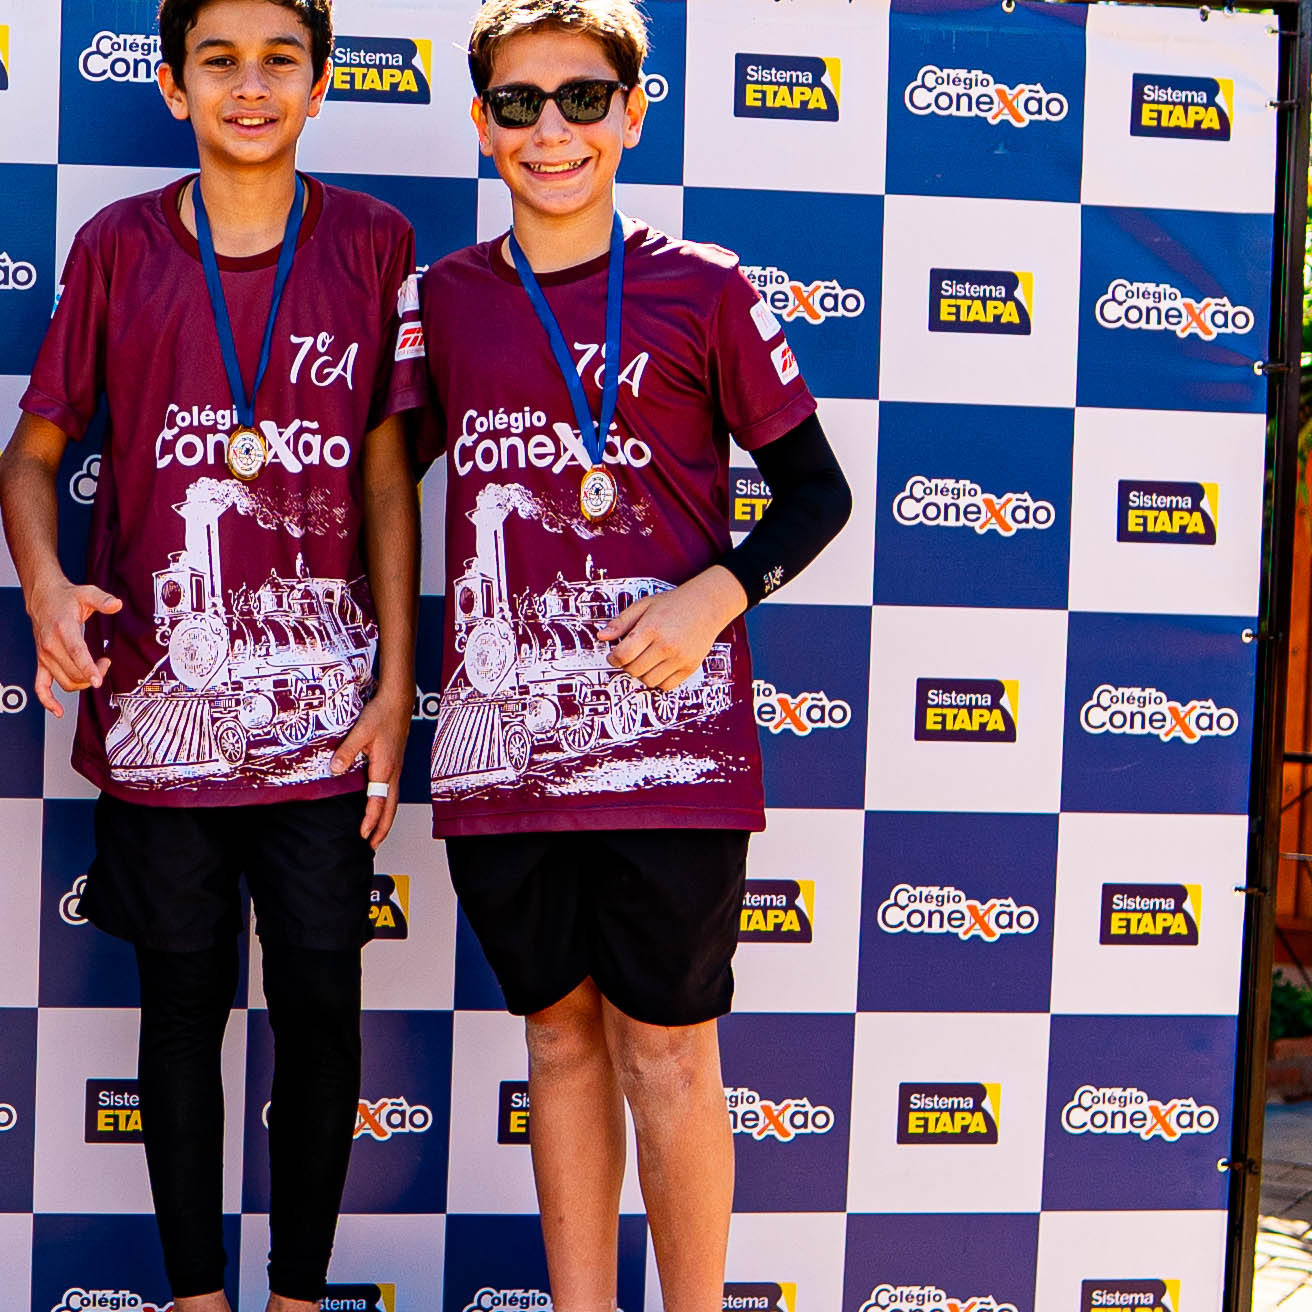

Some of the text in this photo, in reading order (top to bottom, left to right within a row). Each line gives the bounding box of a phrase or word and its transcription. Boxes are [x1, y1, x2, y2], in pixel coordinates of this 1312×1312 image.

[94, 34, 161, 58] Colégi
[333, 47, 403, 67] Sistema
[332, 66, 419, 92] ETAPA
[746, 64, 813, 84] Sistema
[919, 68, 989, 92] Colégio
[745, 83, 828, 109] ETAPA
[1143, 86, 1207, 106] Sistema
[1142, 104, 1221, 131] ETAPA
[741, 268, 786, 287] égio
[941, 278, 1007, 298] Sistema
[1110, 282, 1178, 305] Colégio
[940, 297, 1021, 323] ETAPA
[164, 403, 239, 434] Colégi
[462, 406, 547, 440] Colégio
[908, 478, 978, 502] Colégio
[1129, 490, 1193, 509] Sistema
[1128, 508, 1207, 534] ETAPA
[927, 688, 993, 706] Sistema
[1096, 687, 1163, 711] Colégio
[756, 694, 848, 731] eXão
[926, 706, 1007, 731] ETAPA
[741, 890, 788, 907] tema
[893, 886, 962, 910] Colégio
[1112, 893, 1175, 911] Sistema
[739, 907, 802, 931] TAPA
[1110, 912, 1189, 935] ETAPA
[97, 1090, 139, 1107] Siste
[910, 1092, 975, 1109] Sistema
[1076, 1088, 1144, 1111] Colégio
[96, 1108, 142, 1132] ETA
[908, 1110, 988, 1133] ETAPA
[476, 1289, 548, 1312] Colégio
[721, 1293, 770, 1309] stema
[874, 1287, 943, 1310] Colégio
[1090, 1289, 1153, 1305] Sistema
